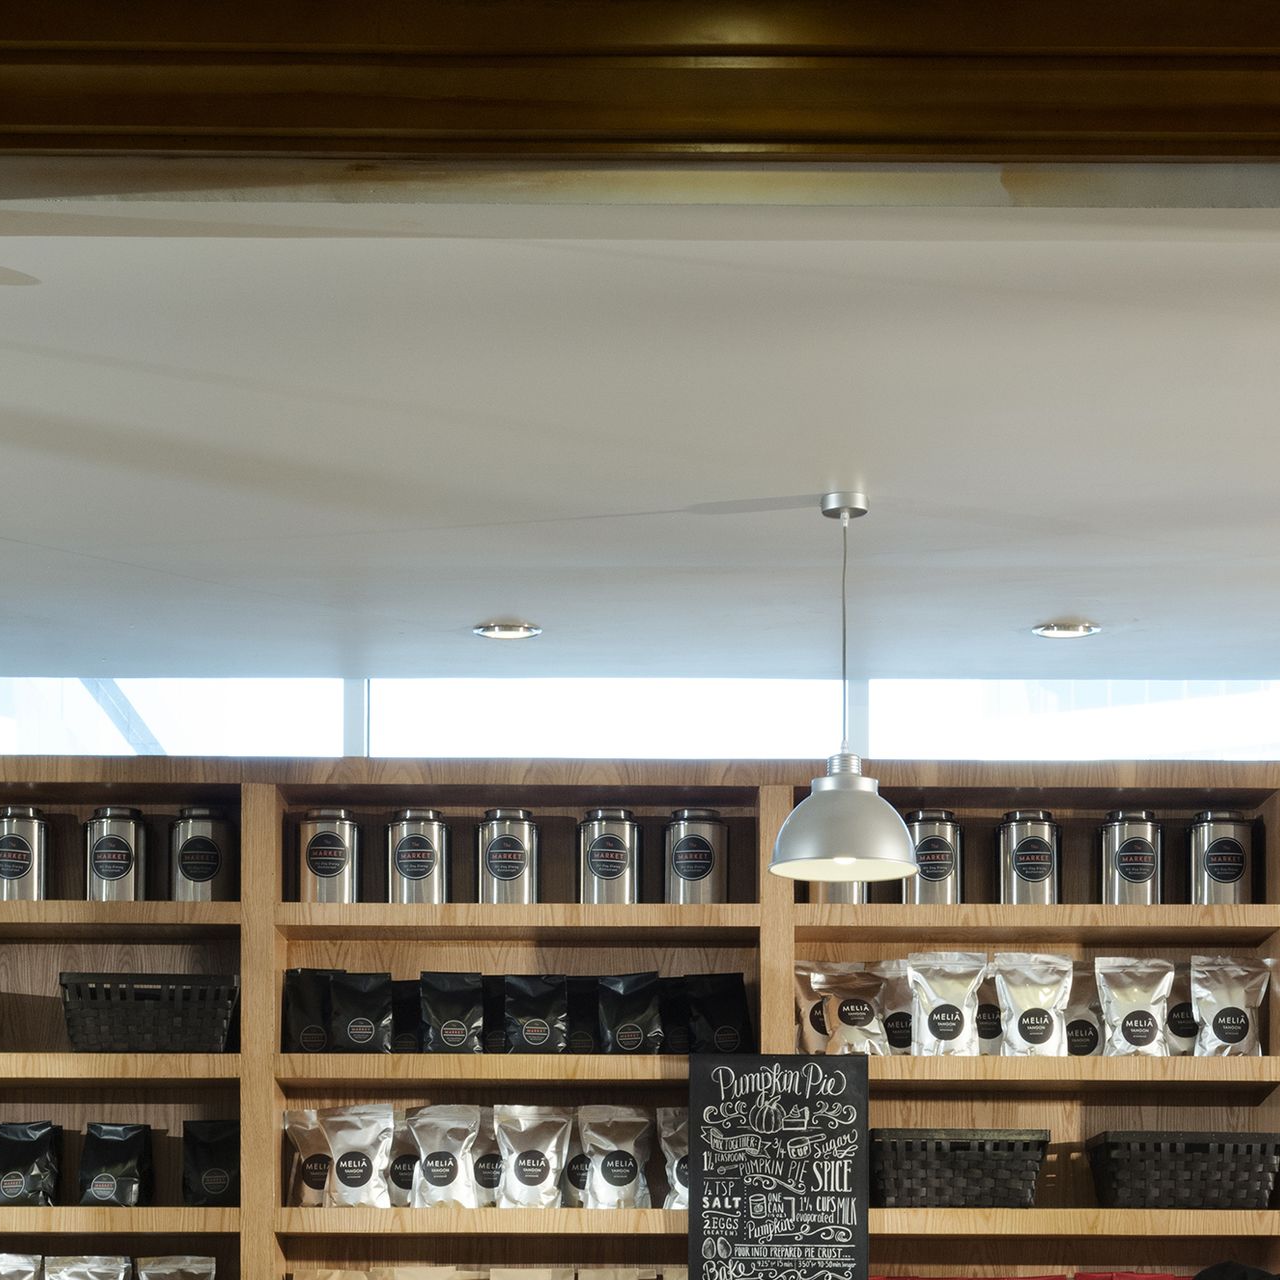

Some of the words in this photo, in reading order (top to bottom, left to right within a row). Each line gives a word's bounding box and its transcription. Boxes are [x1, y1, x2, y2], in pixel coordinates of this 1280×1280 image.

[711, 1063, 801, 1107] Pumpkin
[802, 1062, 847, 1099] Pie
[791, 1146, 808, 1157] CUP
[814, 1129, 858, 1158] Sugar
[739, 1158, 784, 1176] PUMPKIN
[788, 1160, 809, 1183] PIE
[811, 1160, 852, 1192] SPICE
[715, 1181, 735, 1196] TSP
[702, 1196, 741, 1209] SALT
[767, 1193, 782, 1202] ONE
[816, 1196, 836, 1212] CUPS
[768, 1202, 784, 1213] CAN
[837, 1197, 857, 1225] MILK
[703, 1219, 711, 1229] 2
[712, 1217, 739, 1230] EGGS
[796, 1212, 834, 1224] evaporated
[734, 1247, 750, 1257] POUR
[751, 1247, 768, 1257] INTO
[770, 1247, 802, 1258] PREPARED
[804, 1247, 815, 1258] PIE
